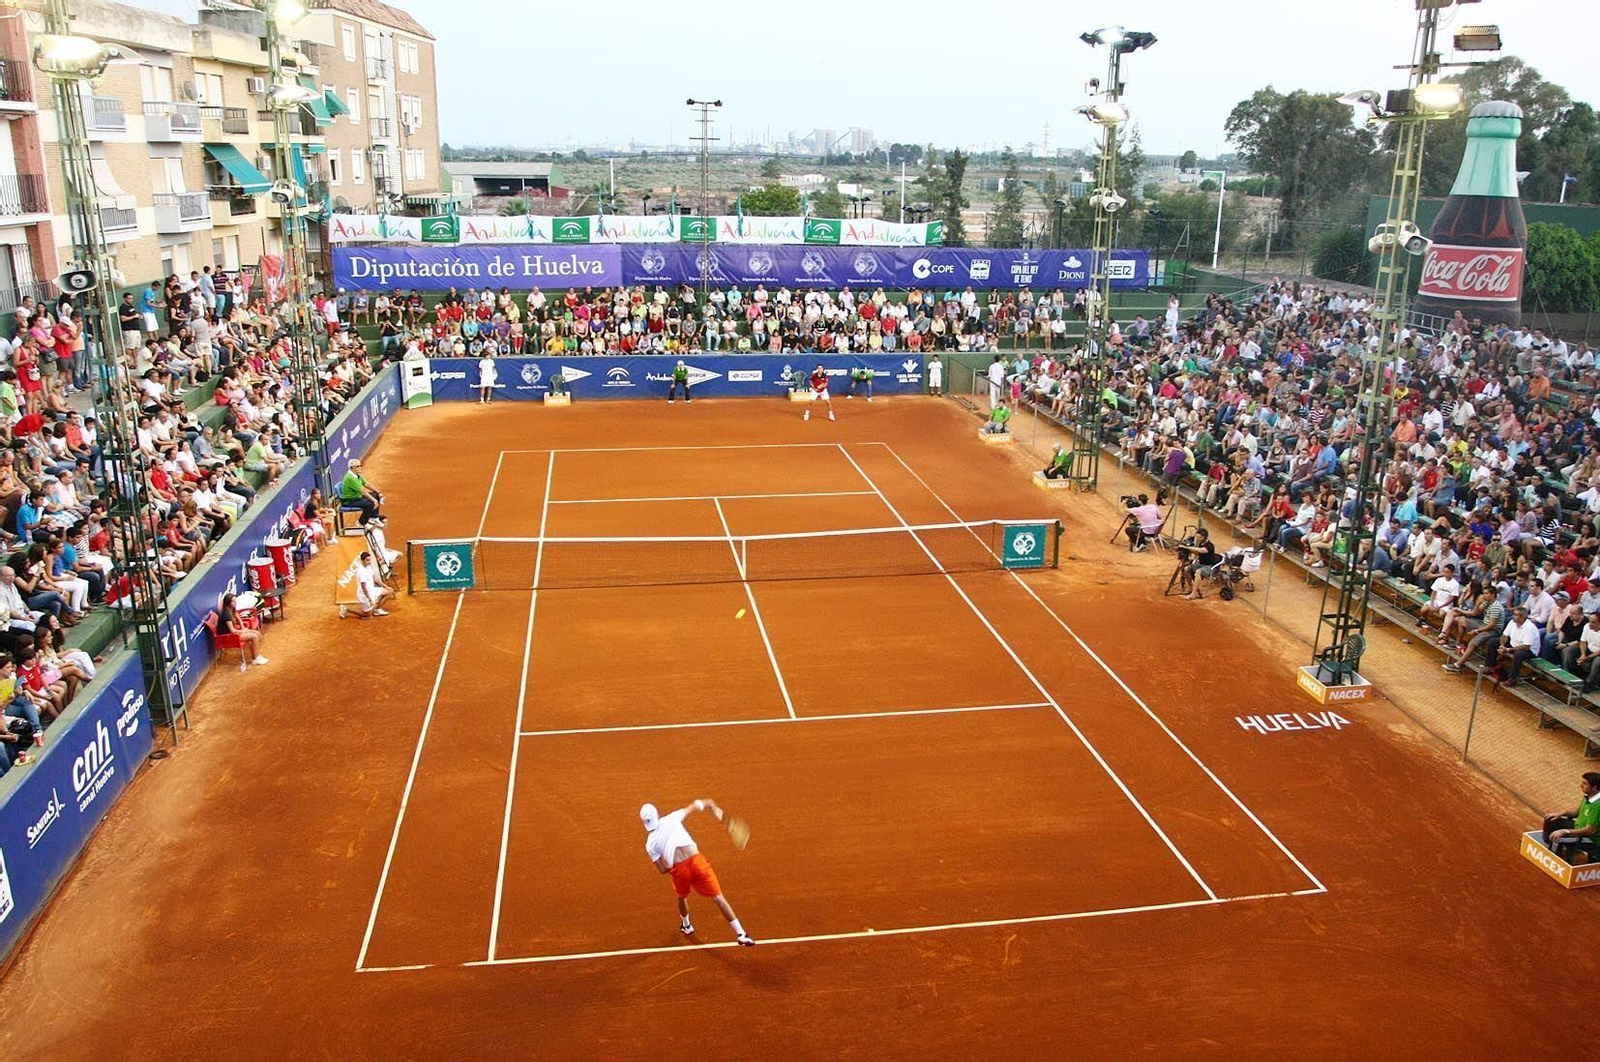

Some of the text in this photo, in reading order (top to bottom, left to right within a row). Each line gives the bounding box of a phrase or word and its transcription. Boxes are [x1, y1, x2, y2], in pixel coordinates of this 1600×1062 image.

[350, 254, 604, 285] Diputación de Huelva
[931, 264, 955, 274] COPE
[1421, 251, 1516, 292] Coca-Cola
[1301, 675, 1322, 697] NACEX
[1328, 689, 1366, 700] NACEX
[1235, 711, 1351, 735] HUELVA
[73, 719, 111, 793] cnh
[1526, 843, 1566, 878] NACEX
